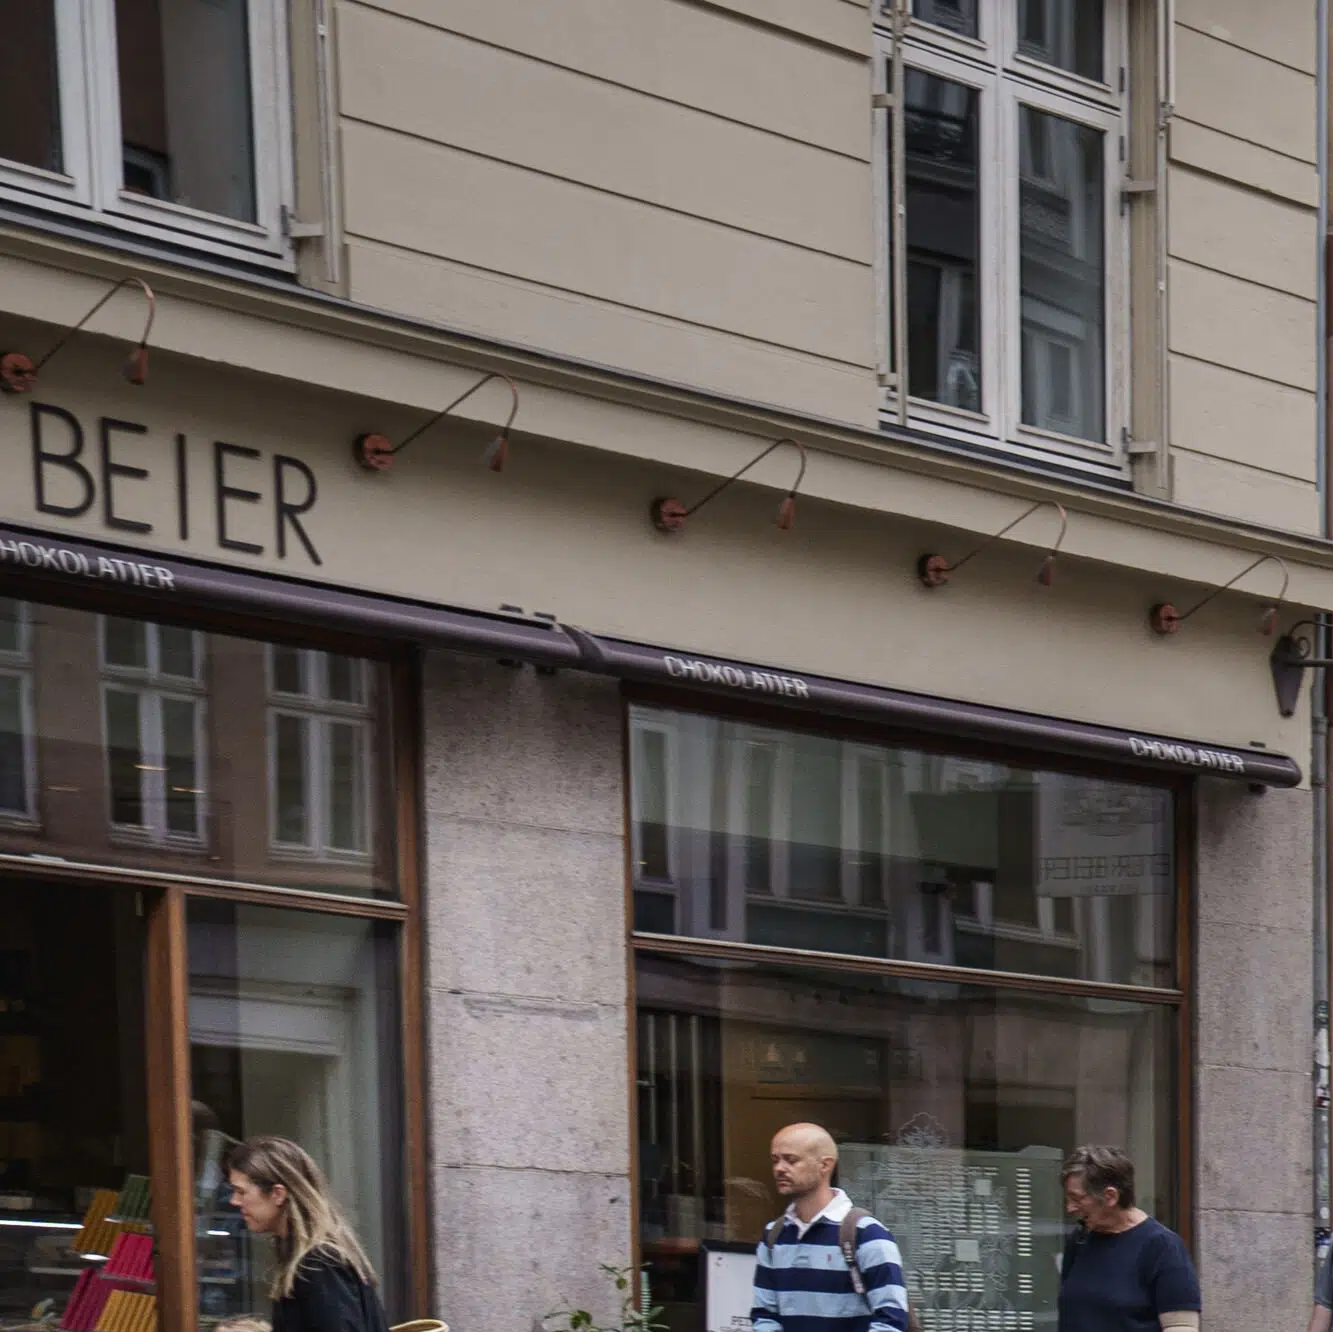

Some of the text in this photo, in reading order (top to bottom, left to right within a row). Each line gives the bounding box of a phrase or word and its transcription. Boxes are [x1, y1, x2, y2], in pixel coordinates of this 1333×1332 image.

[30, 401, 322, 566] BEIER
[0, 539, 176, 591] HOKOLATIER
[664, 656, 809, 698] CHOKOLATIER
[1128, 737, 1245, 772] CHOKOLATIER
